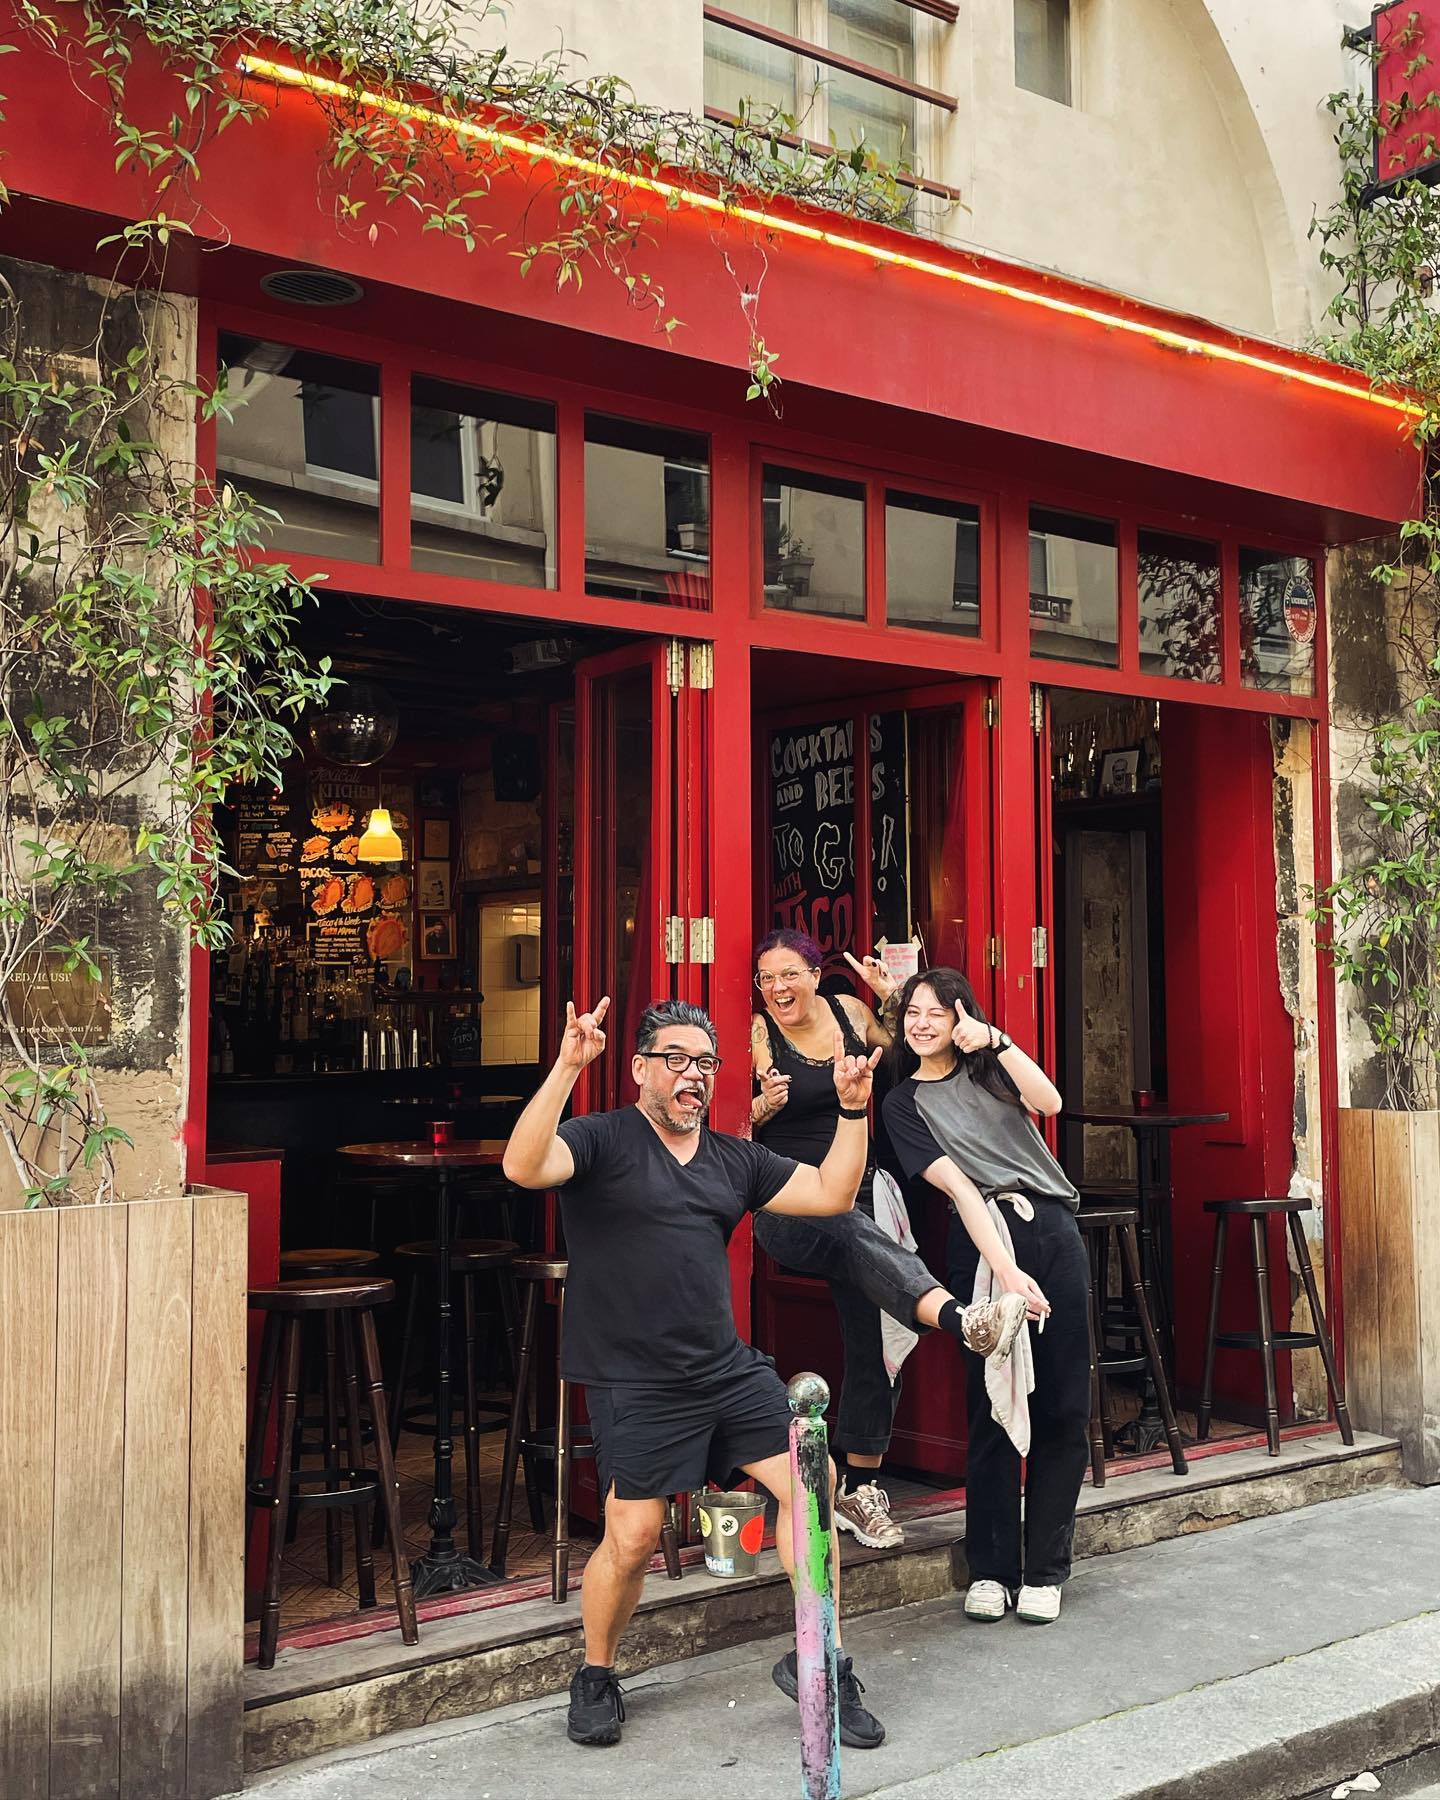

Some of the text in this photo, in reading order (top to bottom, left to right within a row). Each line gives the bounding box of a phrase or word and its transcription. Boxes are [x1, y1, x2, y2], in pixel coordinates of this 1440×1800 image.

[771, 714, 882, 777] COCKTAIS
[776, 762, 885, 811] AND BEES
[297, 867, 332, 879] TACOS
[772, 814, 895, 891] TO G!
[773, 889, 877, 954] TACO
